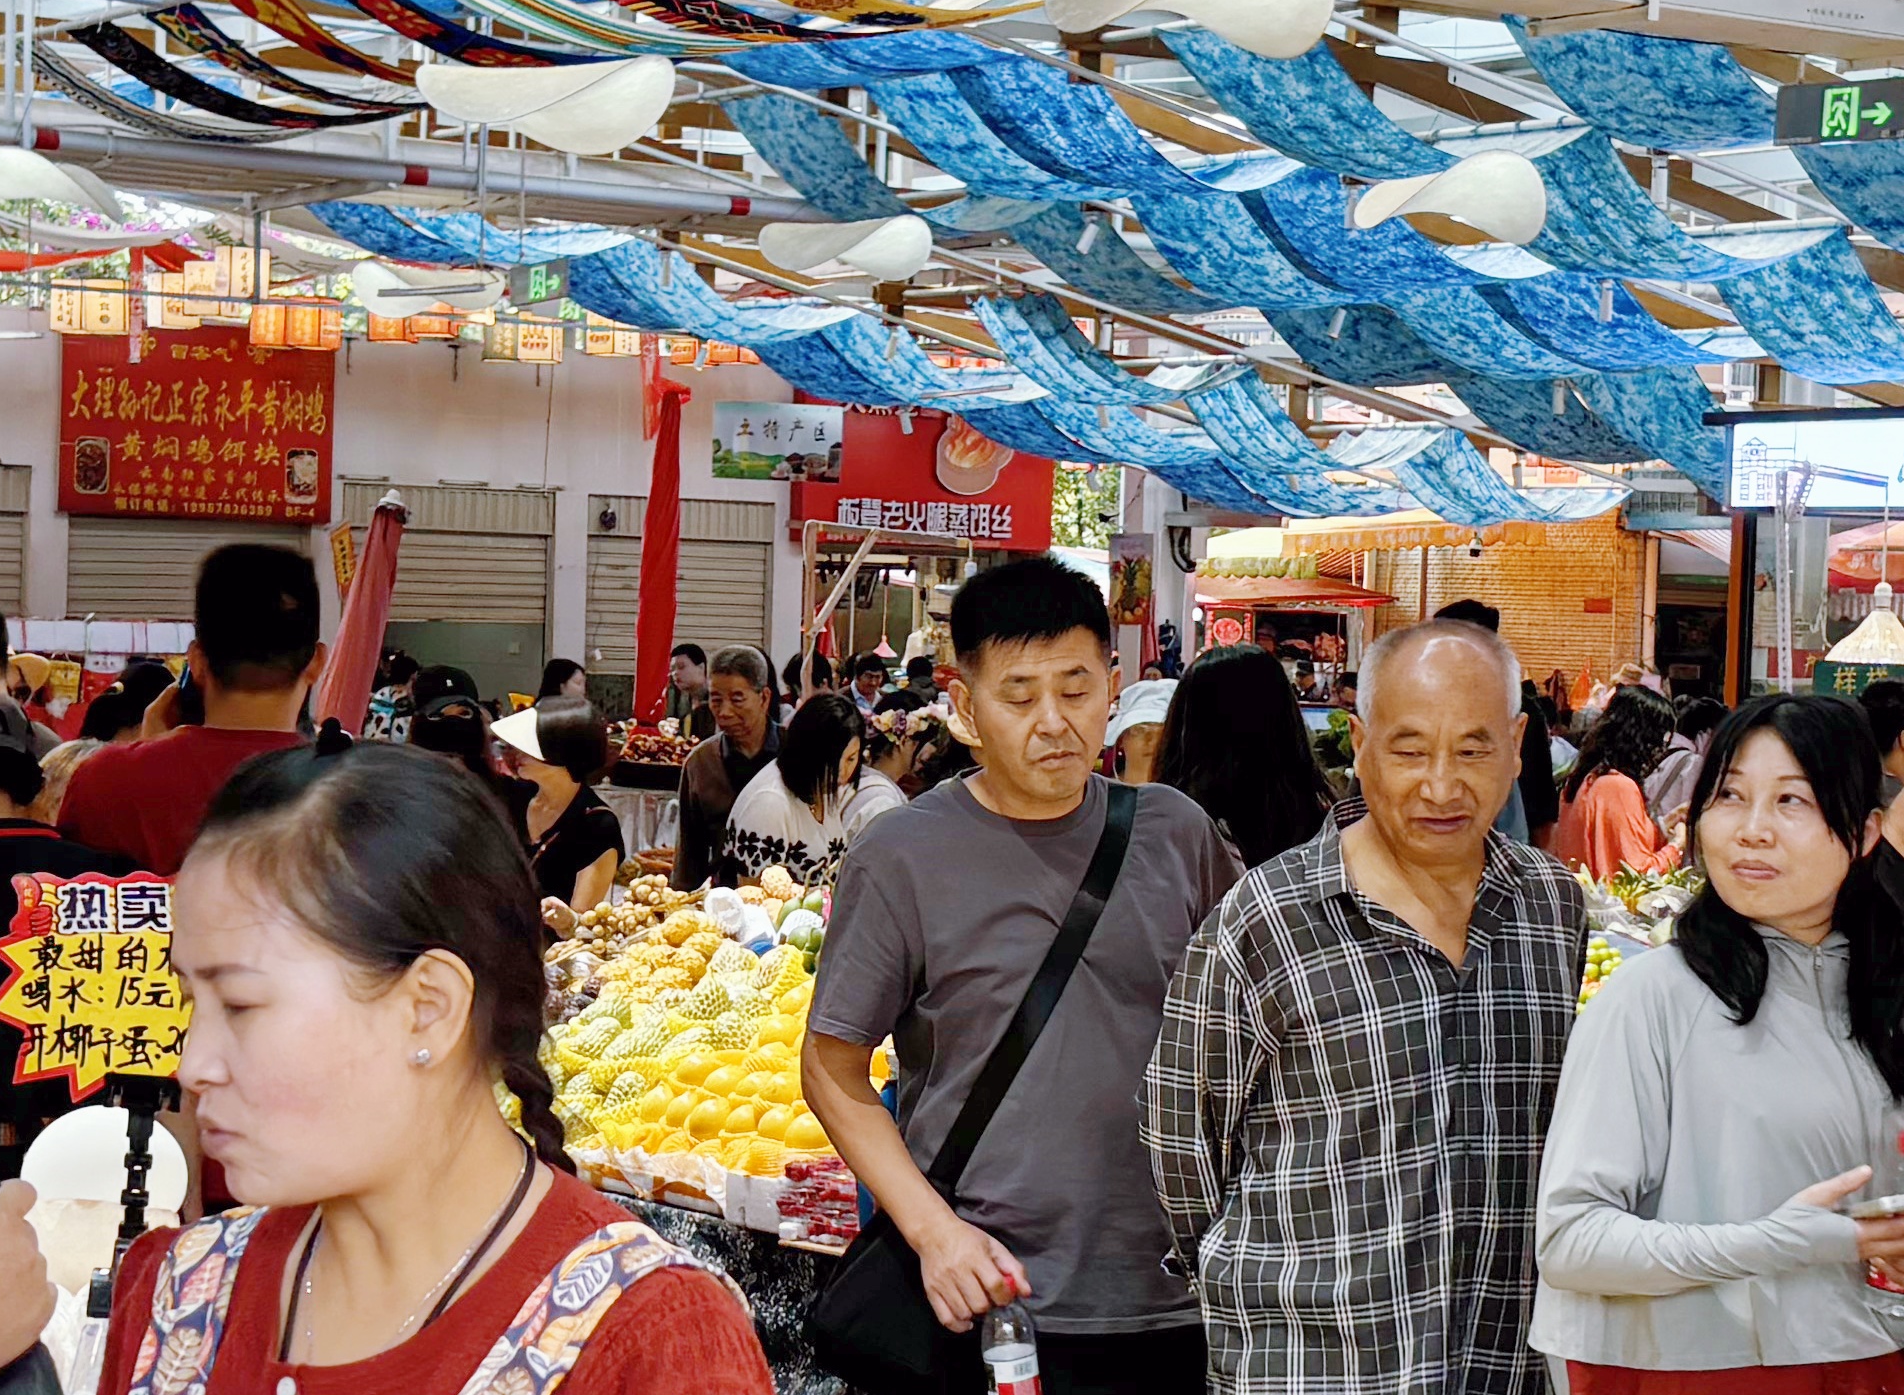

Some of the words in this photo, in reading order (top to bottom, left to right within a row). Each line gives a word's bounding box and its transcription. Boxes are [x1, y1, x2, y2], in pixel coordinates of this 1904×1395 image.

[59, 883, 169, 932] 热卖
[29, 932, 174, 977] 最甜的
